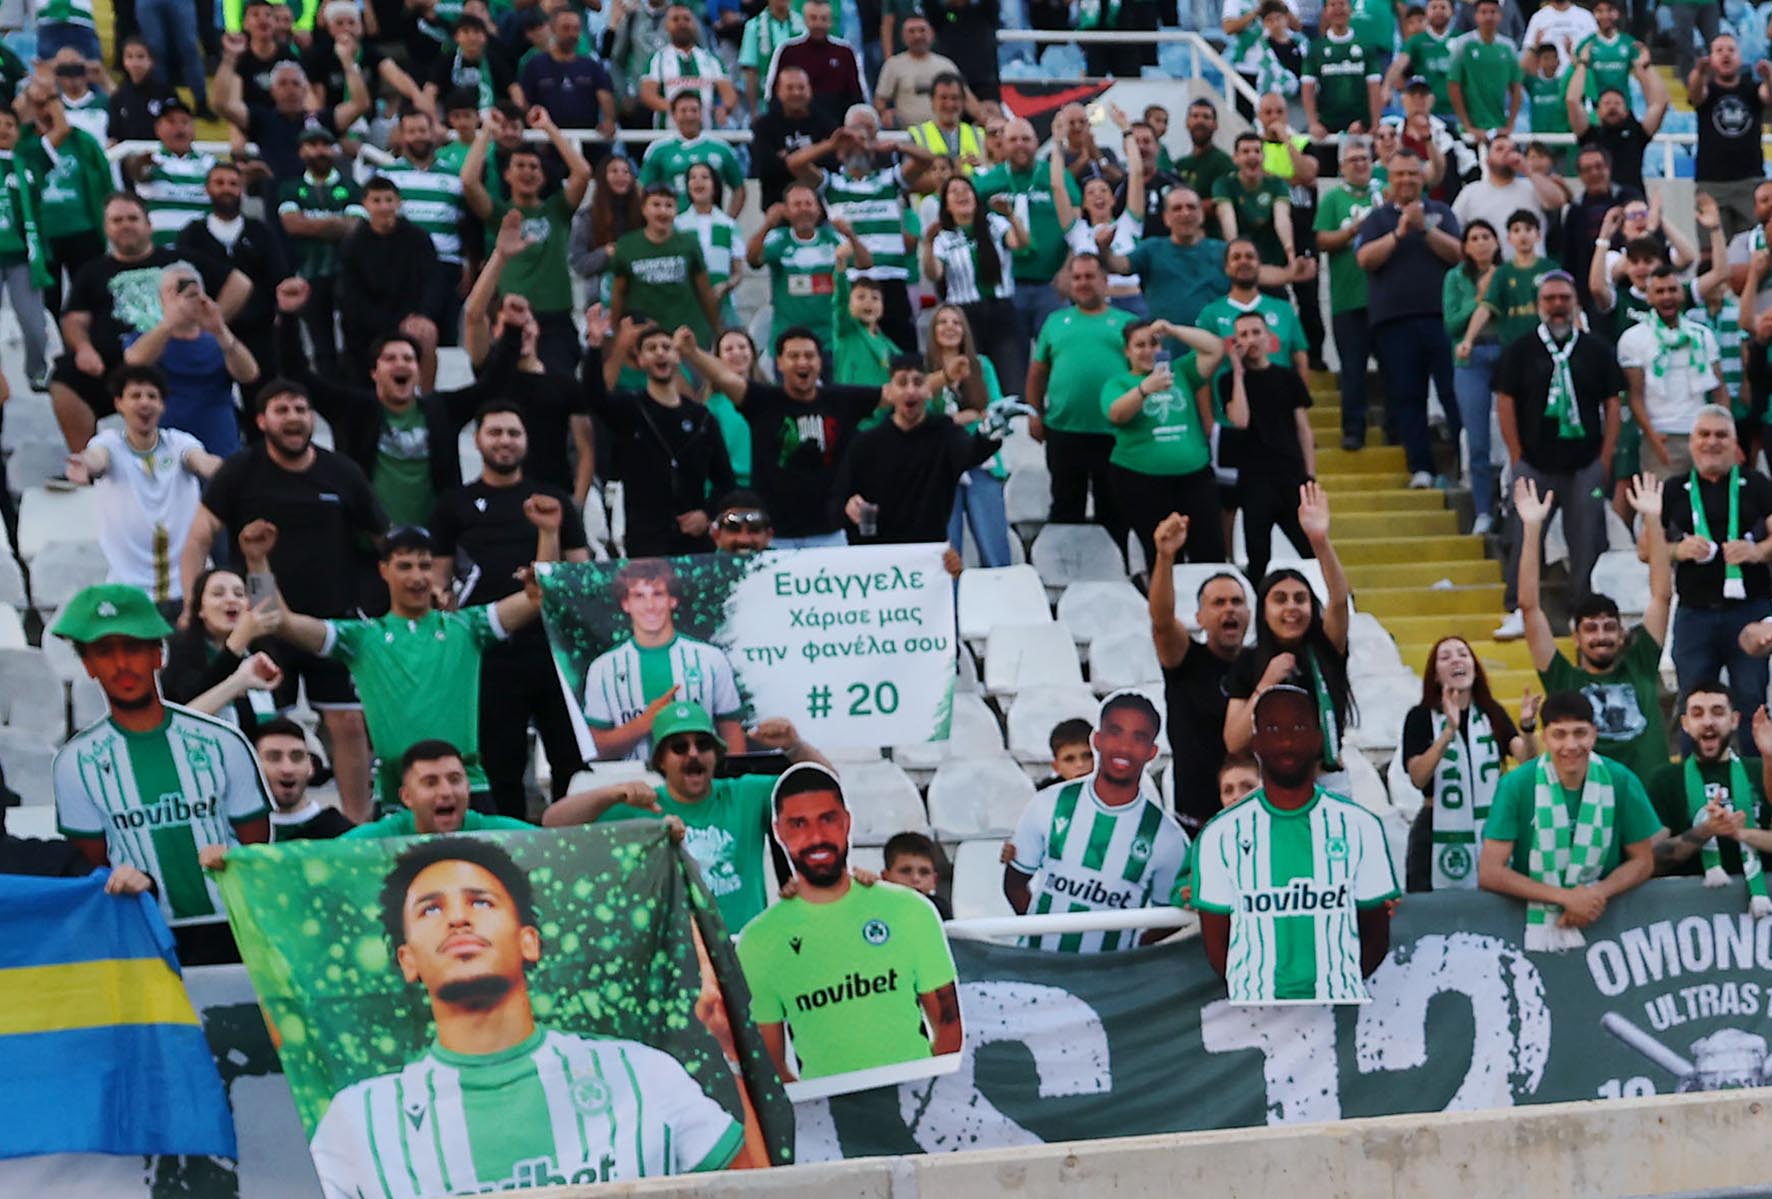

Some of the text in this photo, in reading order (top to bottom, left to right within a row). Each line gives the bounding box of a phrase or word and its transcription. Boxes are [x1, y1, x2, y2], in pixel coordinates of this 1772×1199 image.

[774, 565, 925, 600] Ευάγγελε
[879, 606, 923, 627] μας
[743, 634, 948, 666] την φανέλα σου
[847, 680, 899, 716] 20
[113, 796, 217, 830] novibet
[796, 967, 898, 1013] novibet
[1644, 982, 1760, 1031] ULTRAS
